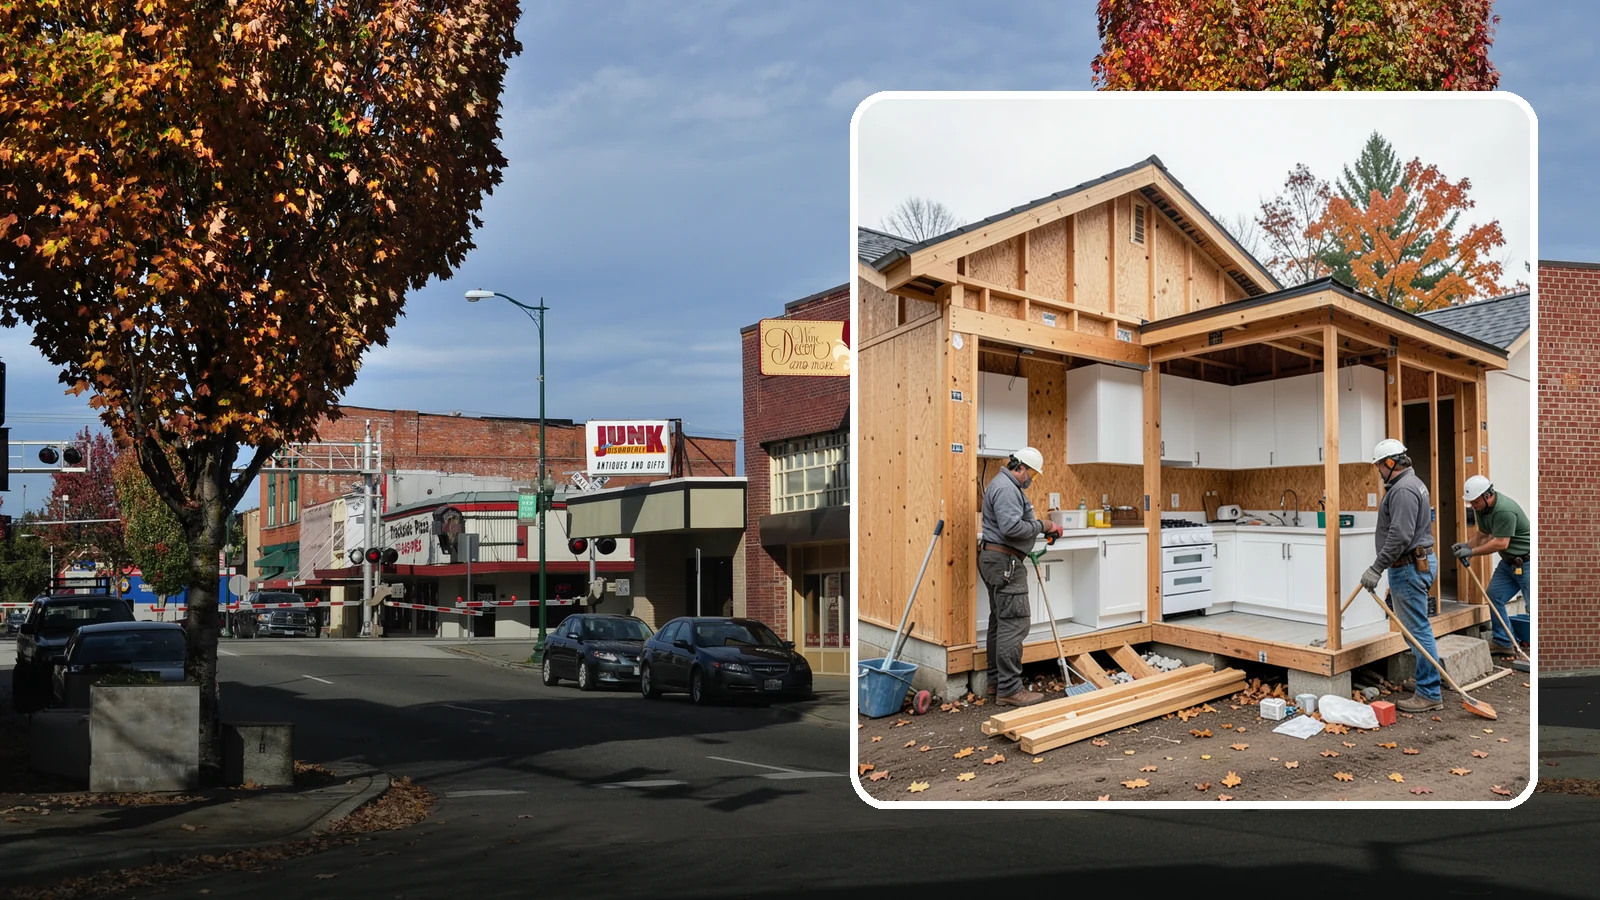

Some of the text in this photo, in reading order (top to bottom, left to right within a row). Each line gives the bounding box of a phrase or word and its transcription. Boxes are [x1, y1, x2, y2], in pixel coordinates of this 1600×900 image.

[595, 425, 665, 457] JUNK
[607, 446, 646, 454] DISORDERLY
[597, 460, 665, 470] ANTIQUES AND GIFTS
[390, 519, 429, 540] Trackside Pizza
